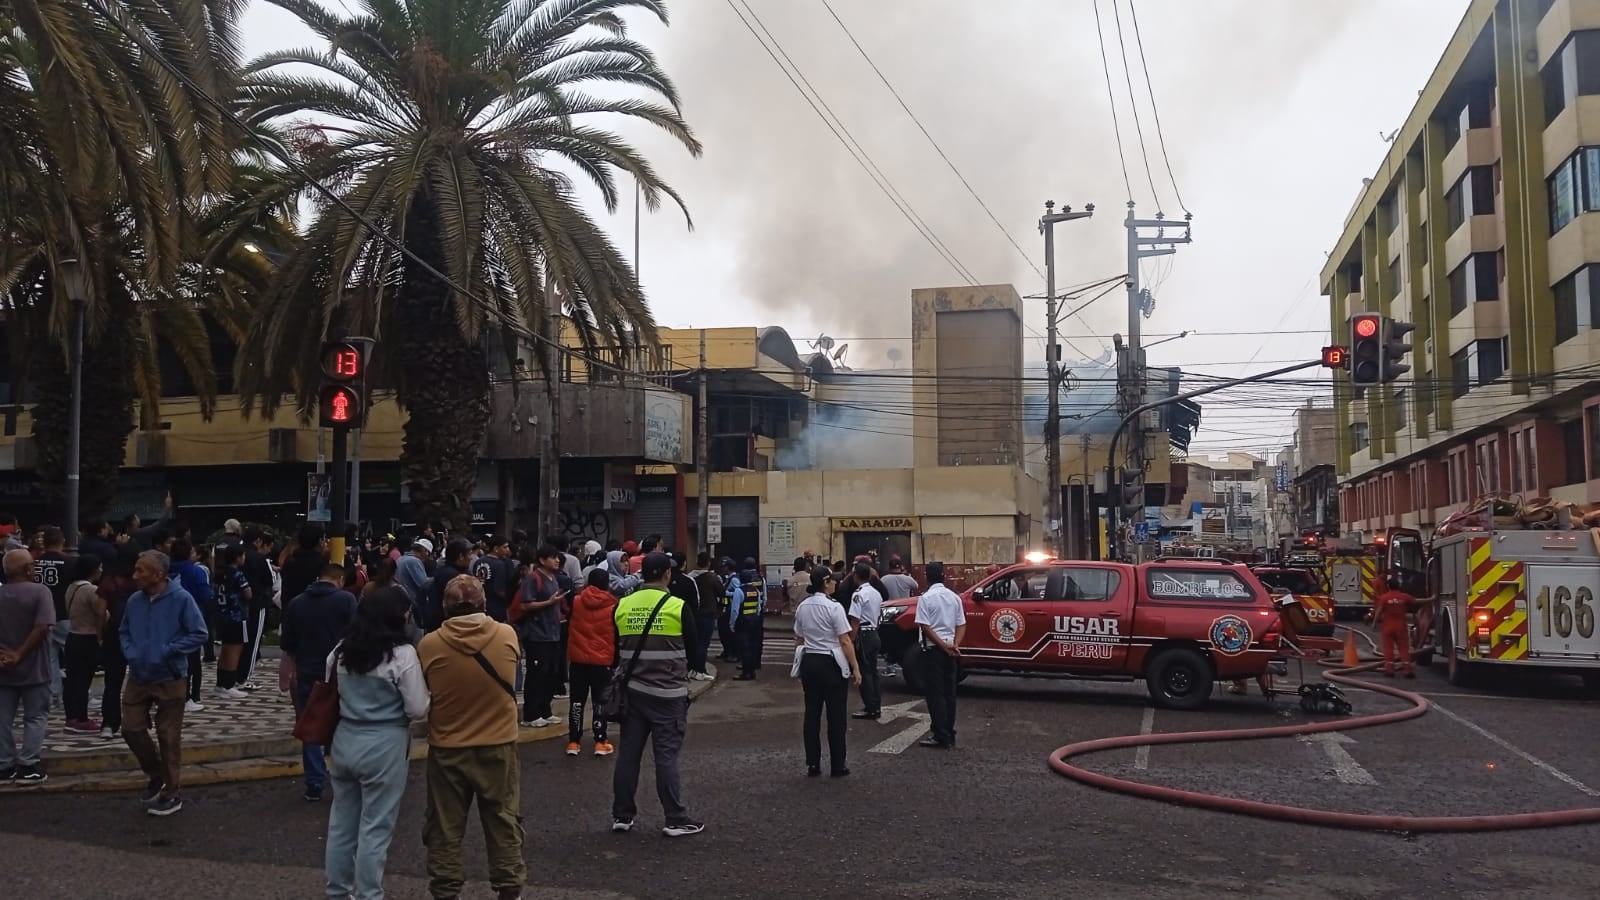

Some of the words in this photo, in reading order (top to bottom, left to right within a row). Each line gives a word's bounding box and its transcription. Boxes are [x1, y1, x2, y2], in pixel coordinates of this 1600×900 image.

[337, 352, 357, 375] 13
[1330, 352, 1340, 363] 13
[840, 519, 858, 528] LA
[862, 519, 913, 528] RAMPA
[1334, 569, 1361, 592] 24
[1536, 585, 1594, 638] 166
[1054, 615, 1120, 635] USAR
[1058, 642, 1113, 659] PERU
